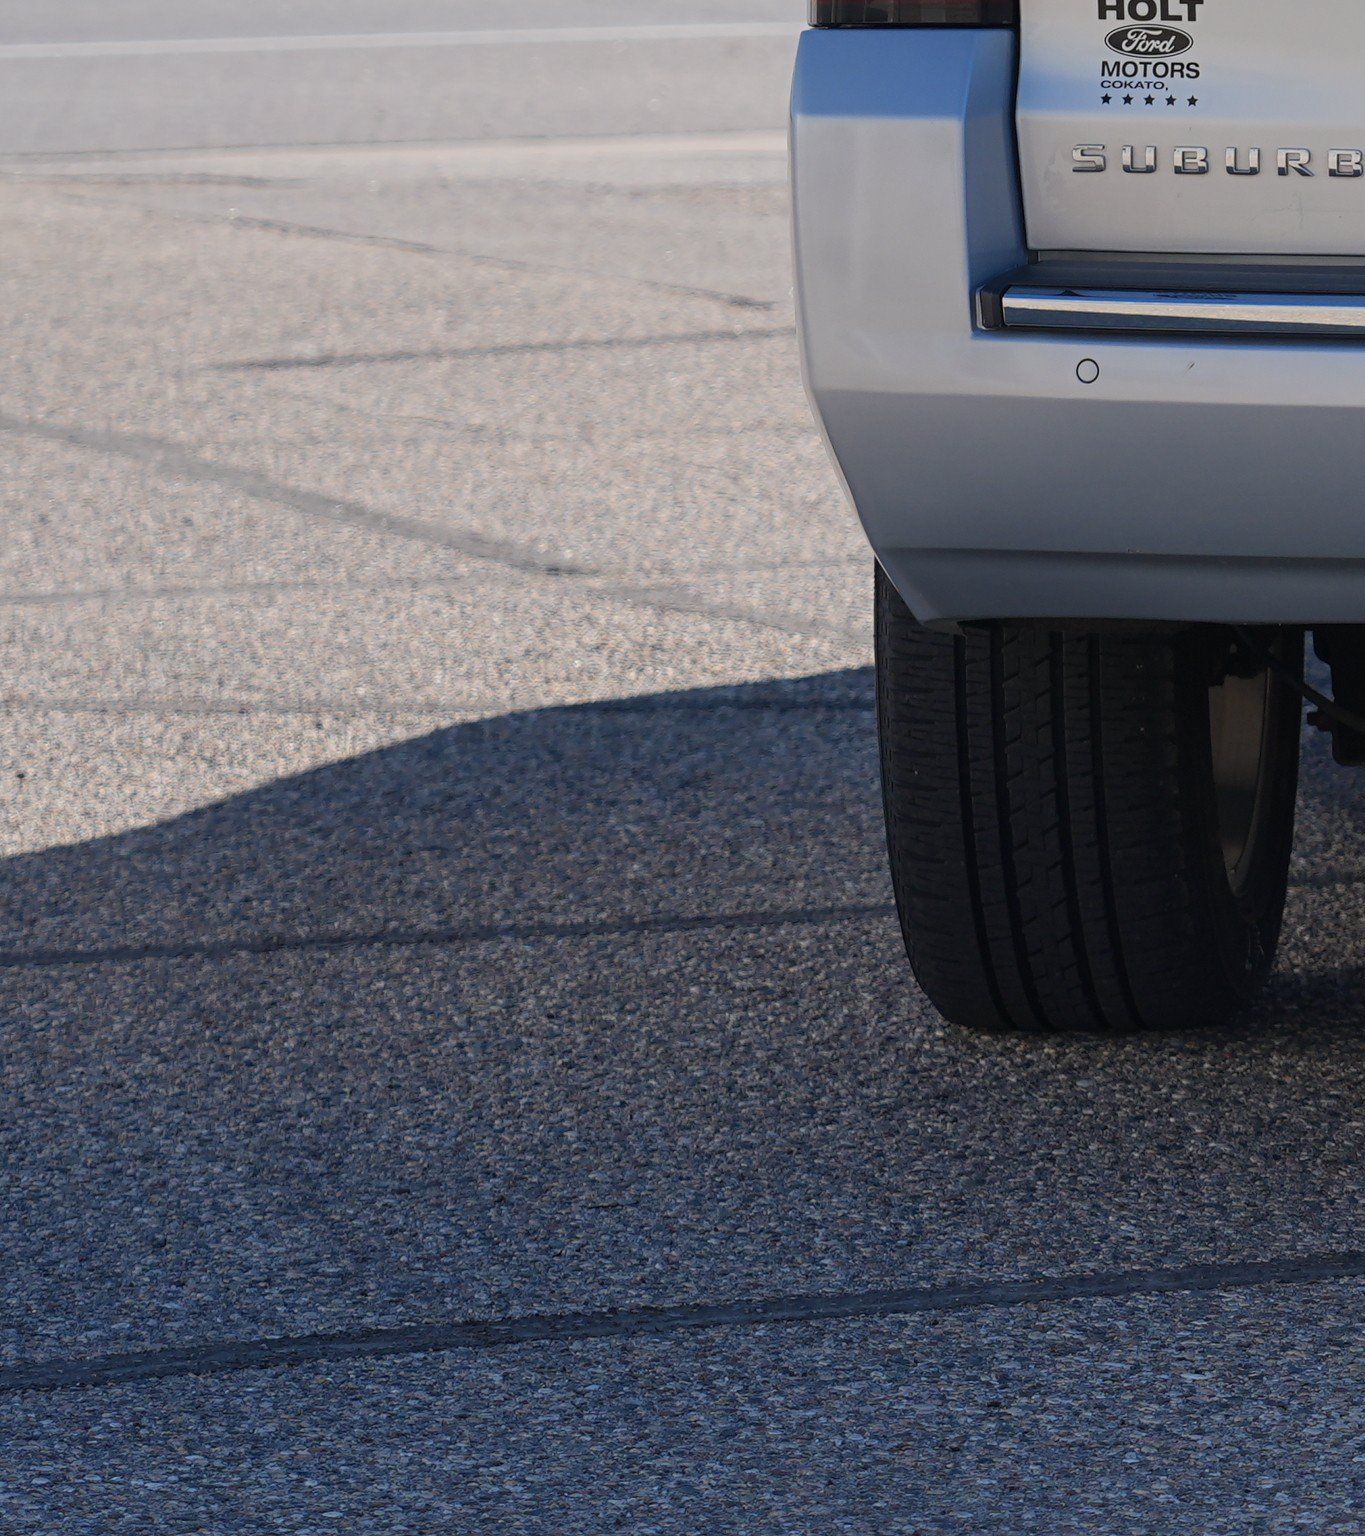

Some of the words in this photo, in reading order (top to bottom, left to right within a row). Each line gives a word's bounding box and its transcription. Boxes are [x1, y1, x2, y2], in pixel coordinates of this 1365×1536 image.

[1121, 28, 1177, 53] Ford
[1101, 60, 1201, 79] MOTORS
[1100, 80, 1169, 91] COKATO,
